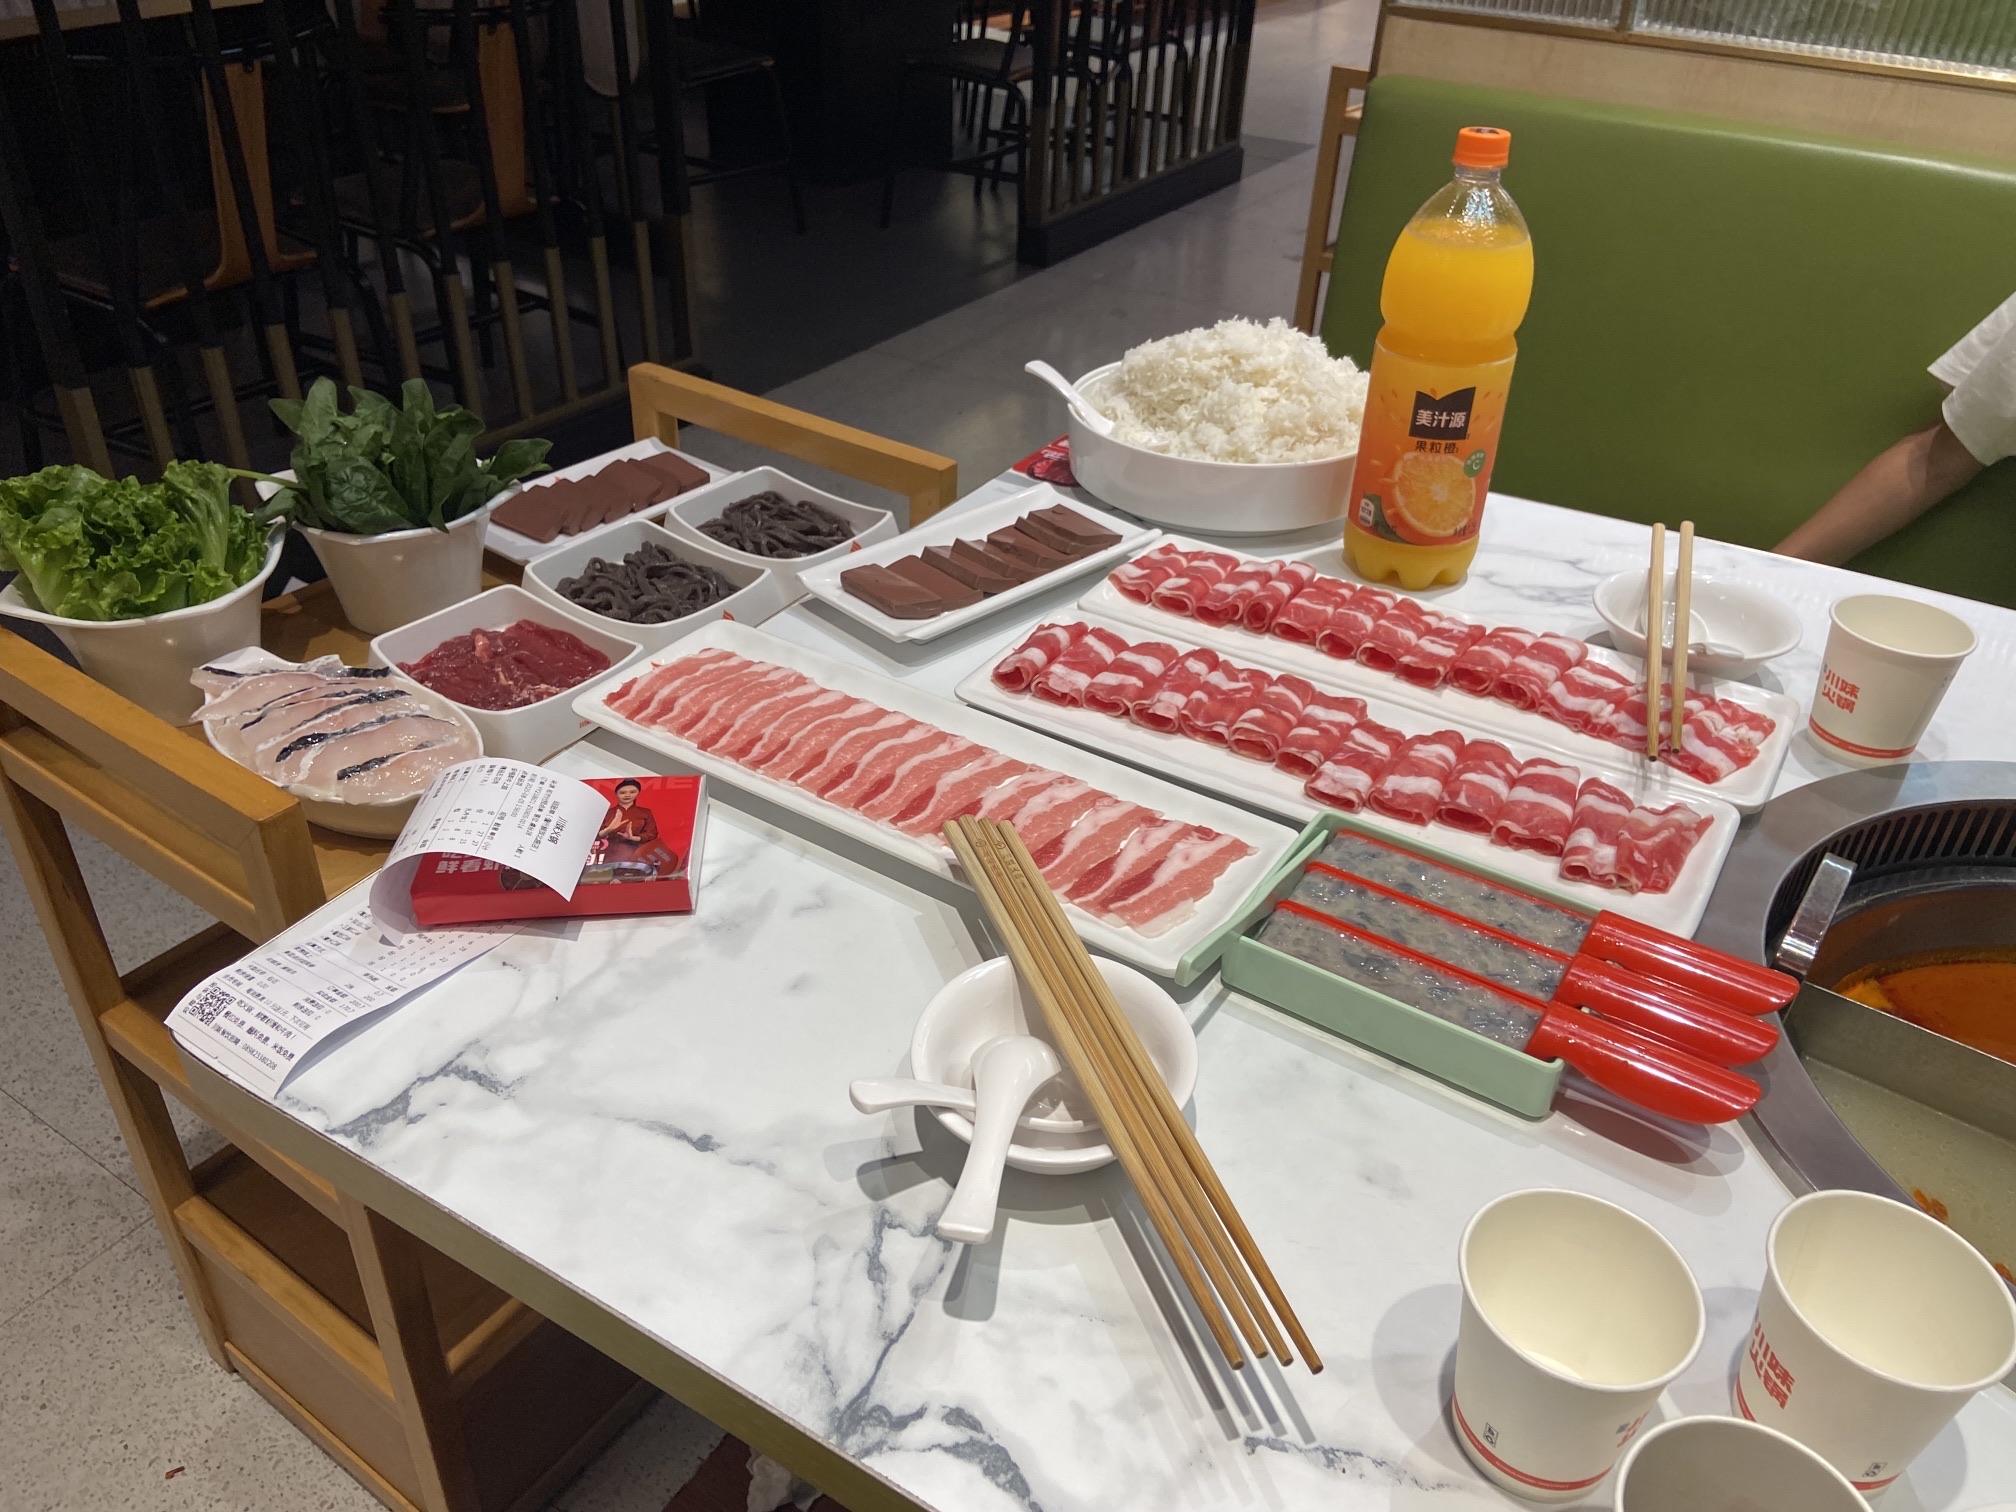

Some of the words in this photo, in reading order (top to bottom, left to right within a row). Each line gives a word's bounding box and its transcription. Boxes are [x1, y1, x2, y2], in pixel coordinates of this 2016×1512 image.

[1415, 410, 1466, 428] 美汁源
[1414, 440, 1456, 453] 果粒橙
